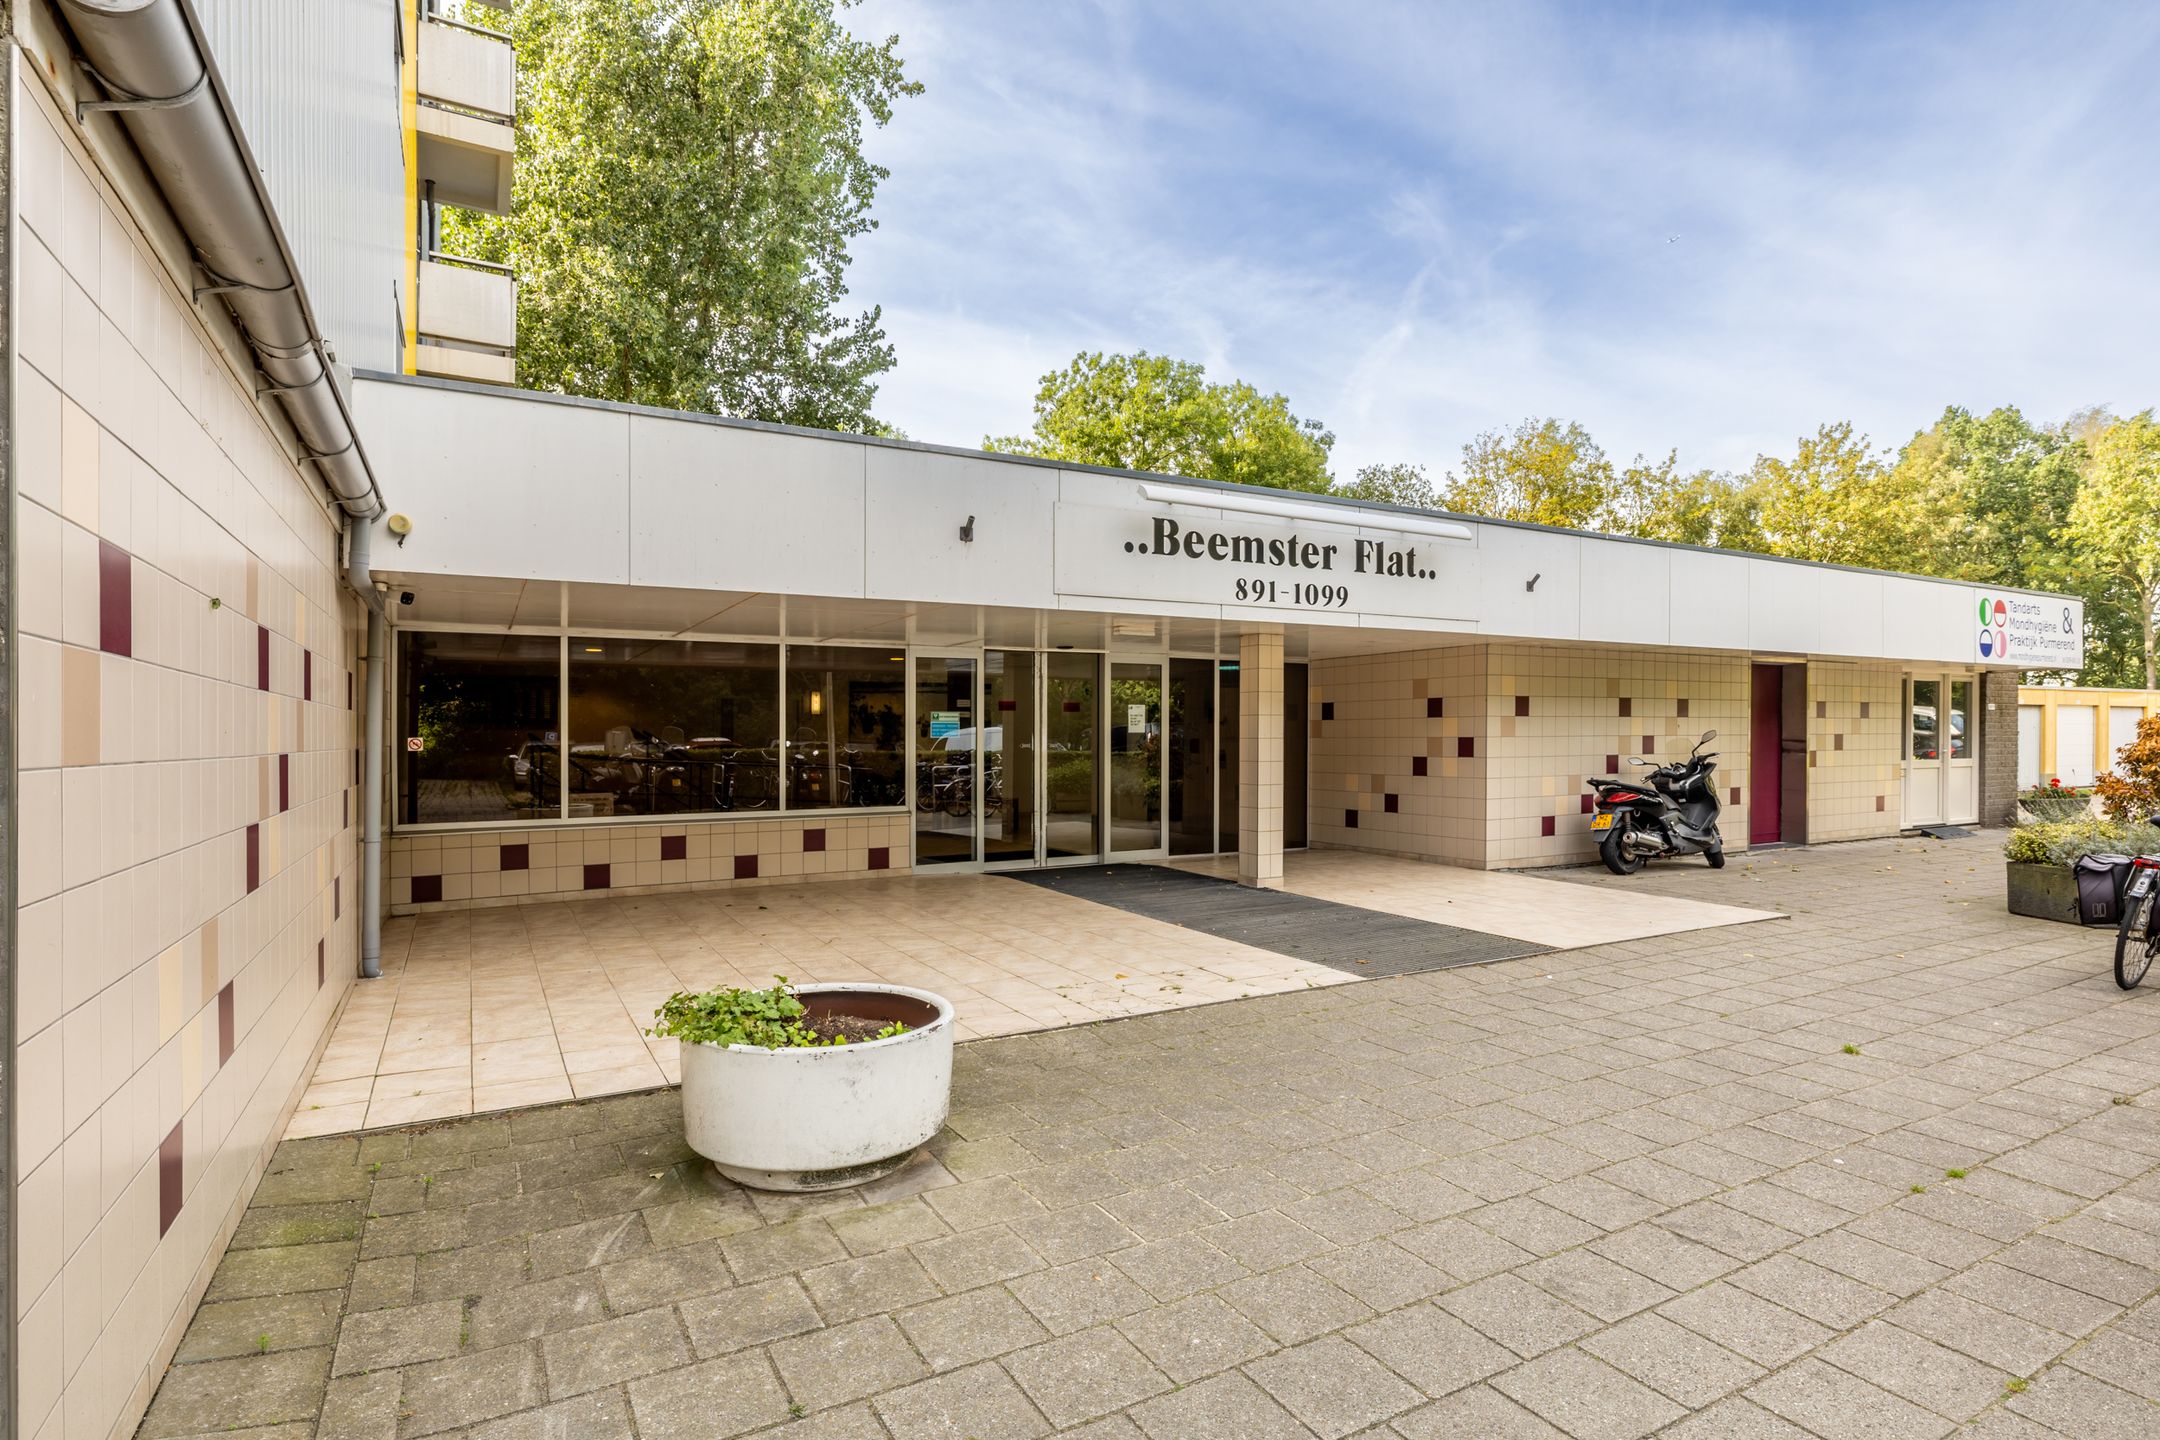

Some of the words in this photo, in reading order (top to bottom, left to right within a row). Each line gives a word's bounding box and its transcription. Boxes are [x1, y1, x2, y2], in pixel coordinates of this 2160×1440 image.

[1235, 577, 1349, 608] 891-1099
[2008, 600, 2040, 616] Tandarts
[2062, 607, 2074, 634] &
[2009, 634, 2037, 650] Praktijk
[2040, 636, 2075, 650] Purmerend
